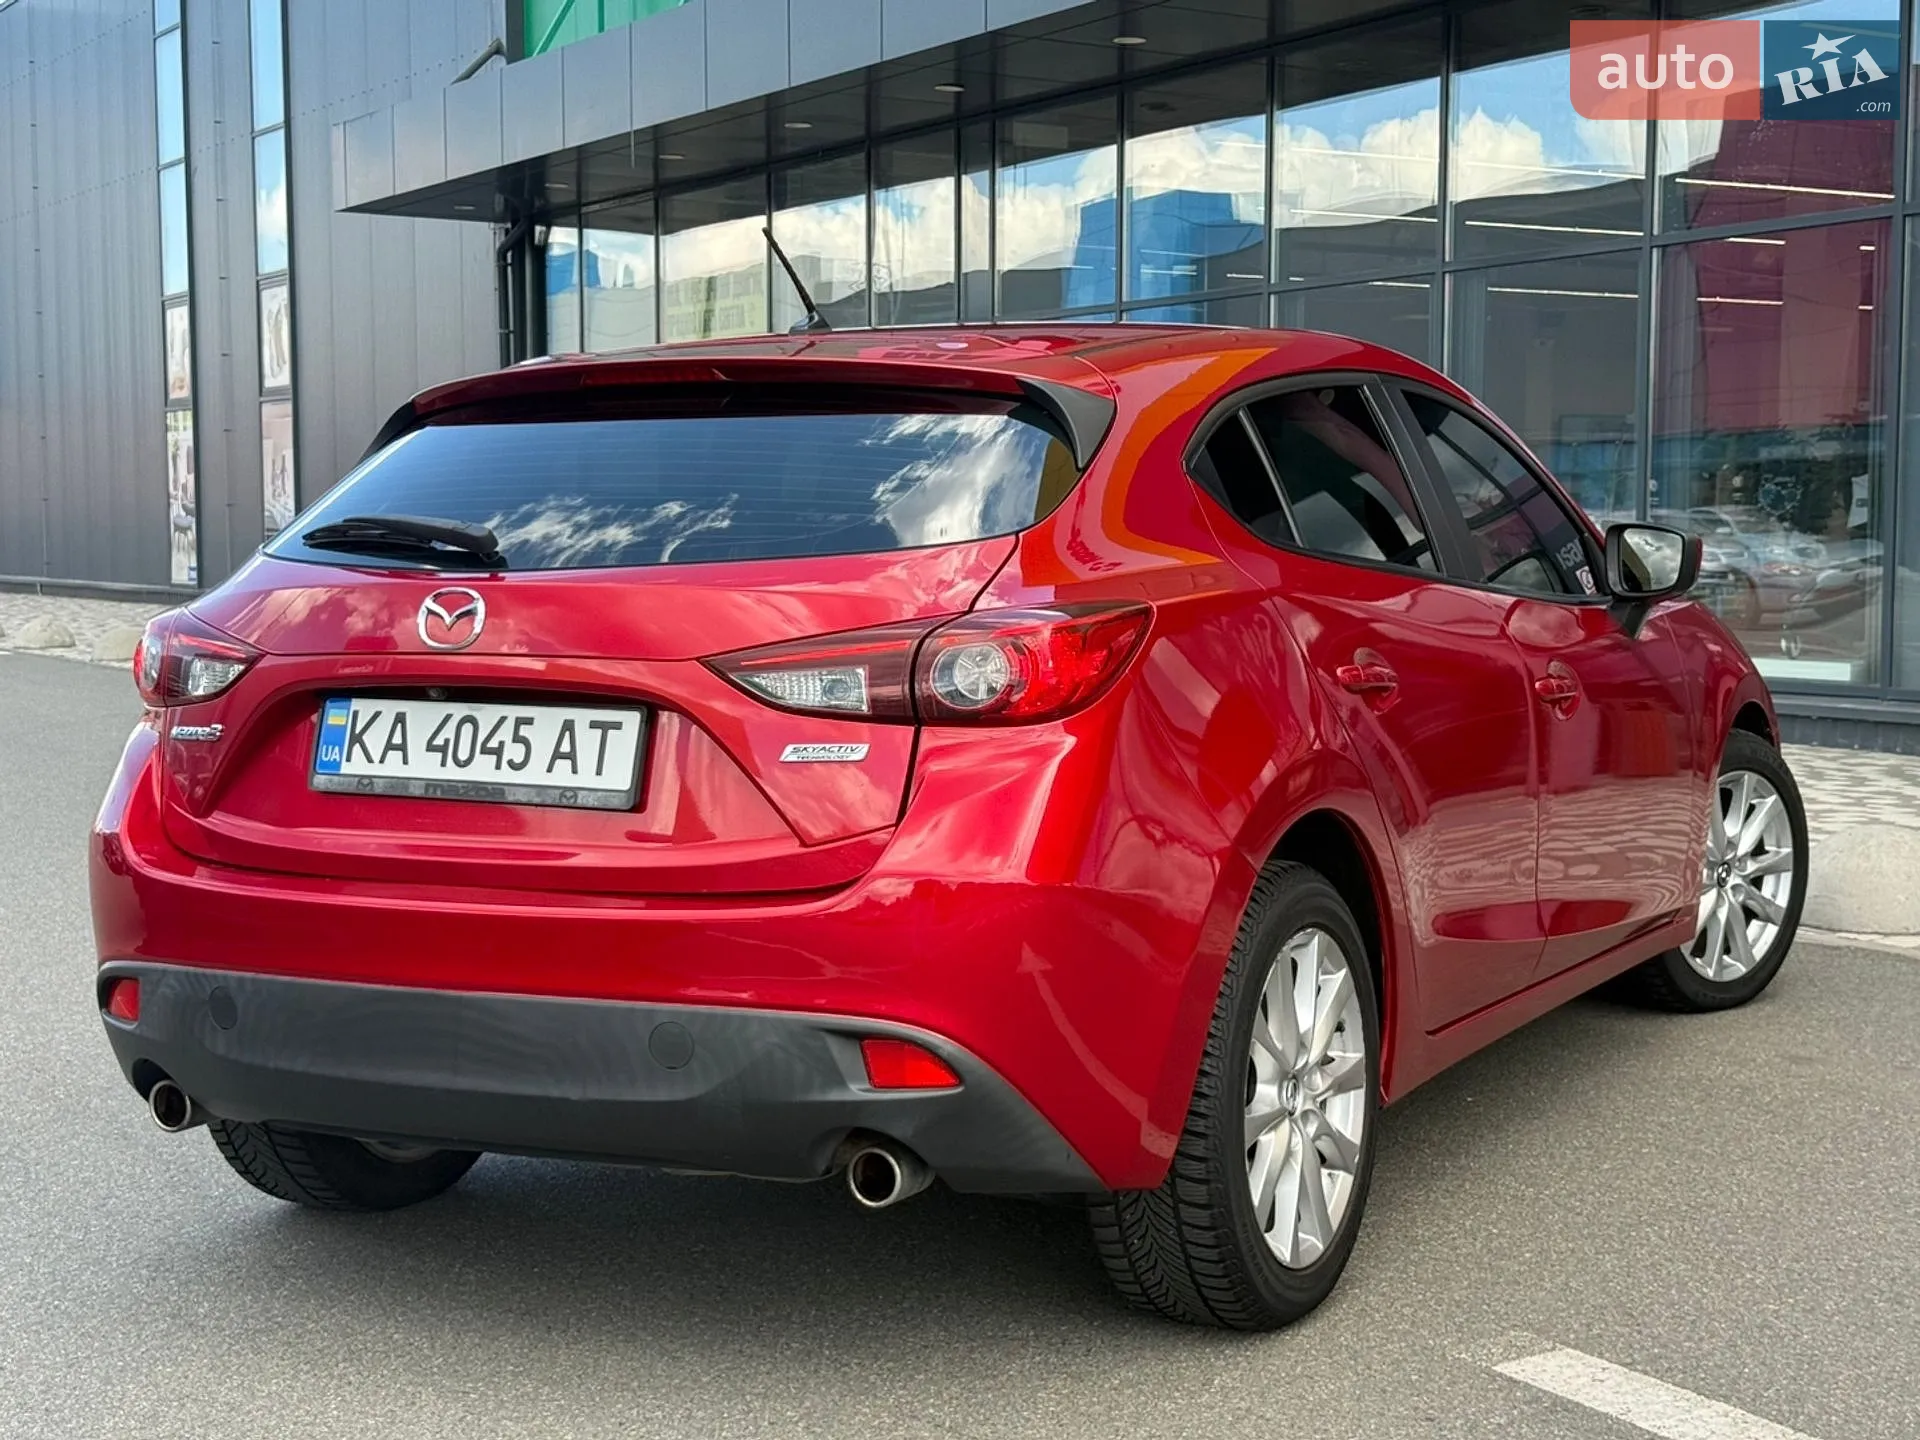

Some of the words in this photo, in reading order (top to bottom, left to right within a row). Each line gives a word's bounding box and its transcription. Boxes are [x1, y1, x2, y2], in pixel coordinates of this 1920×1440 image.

[345, 709, 410, 765] KA
[425, 713, 535, 771] 4045
[546, 718, 623, 776] AT
[790, 745, 859, 754] SKYACTIV
[321, 744, 340, 762] UA
